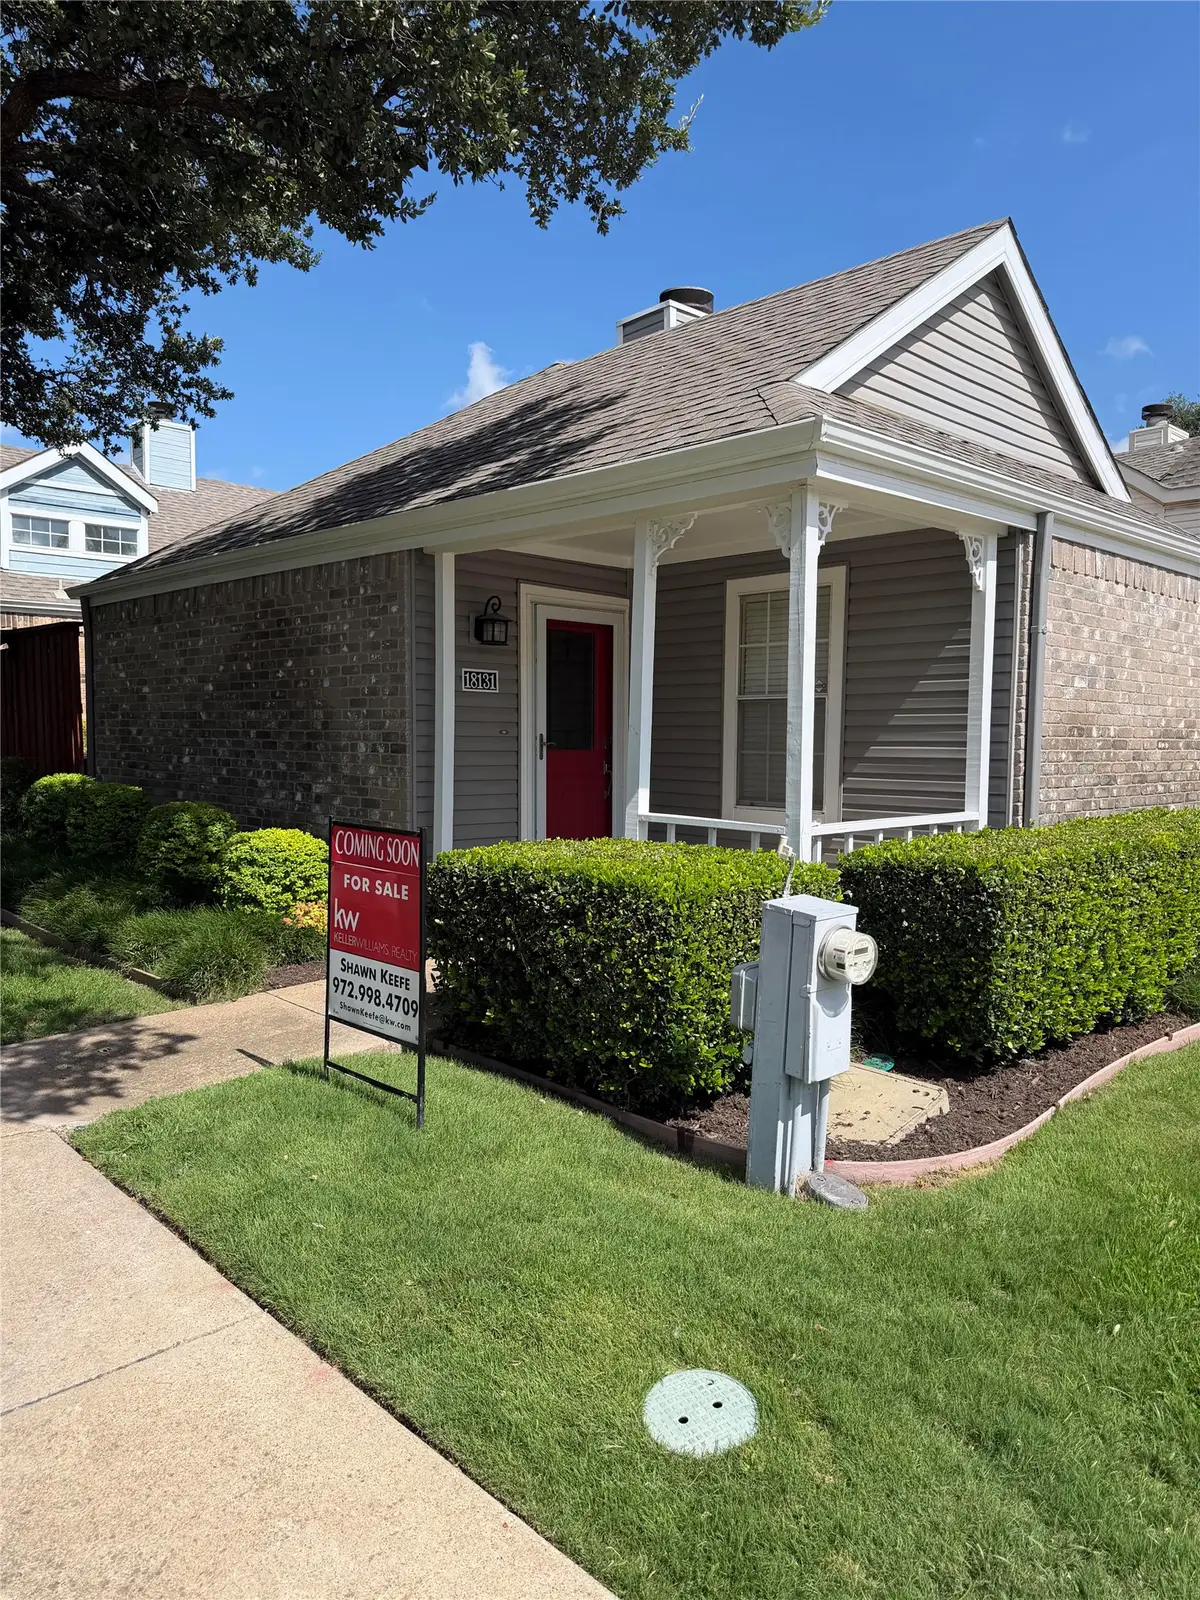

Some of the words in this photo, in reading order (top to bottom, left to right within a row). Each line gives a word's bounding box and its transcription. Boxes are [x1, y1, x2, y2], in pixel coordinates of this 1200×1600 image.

[464, 672, 497, 690] 18131
[335, 830, 384, 862] COMING
[387, 837, 419, 868] SOON
[343, 873, 370, 893] FOR
[375, 879, 409, 901] SALE
[334, 898, 360, 932] kw
[391, 945, 418, 963] REALTY
[340, 957, 377, 981] SHAWN
[380, 968, 411, 991] KEEFE
[332, 976, 419, 1018] 972.998.4709
[339, 1001, 412, 1032] ShawnKeefe@kw.com
